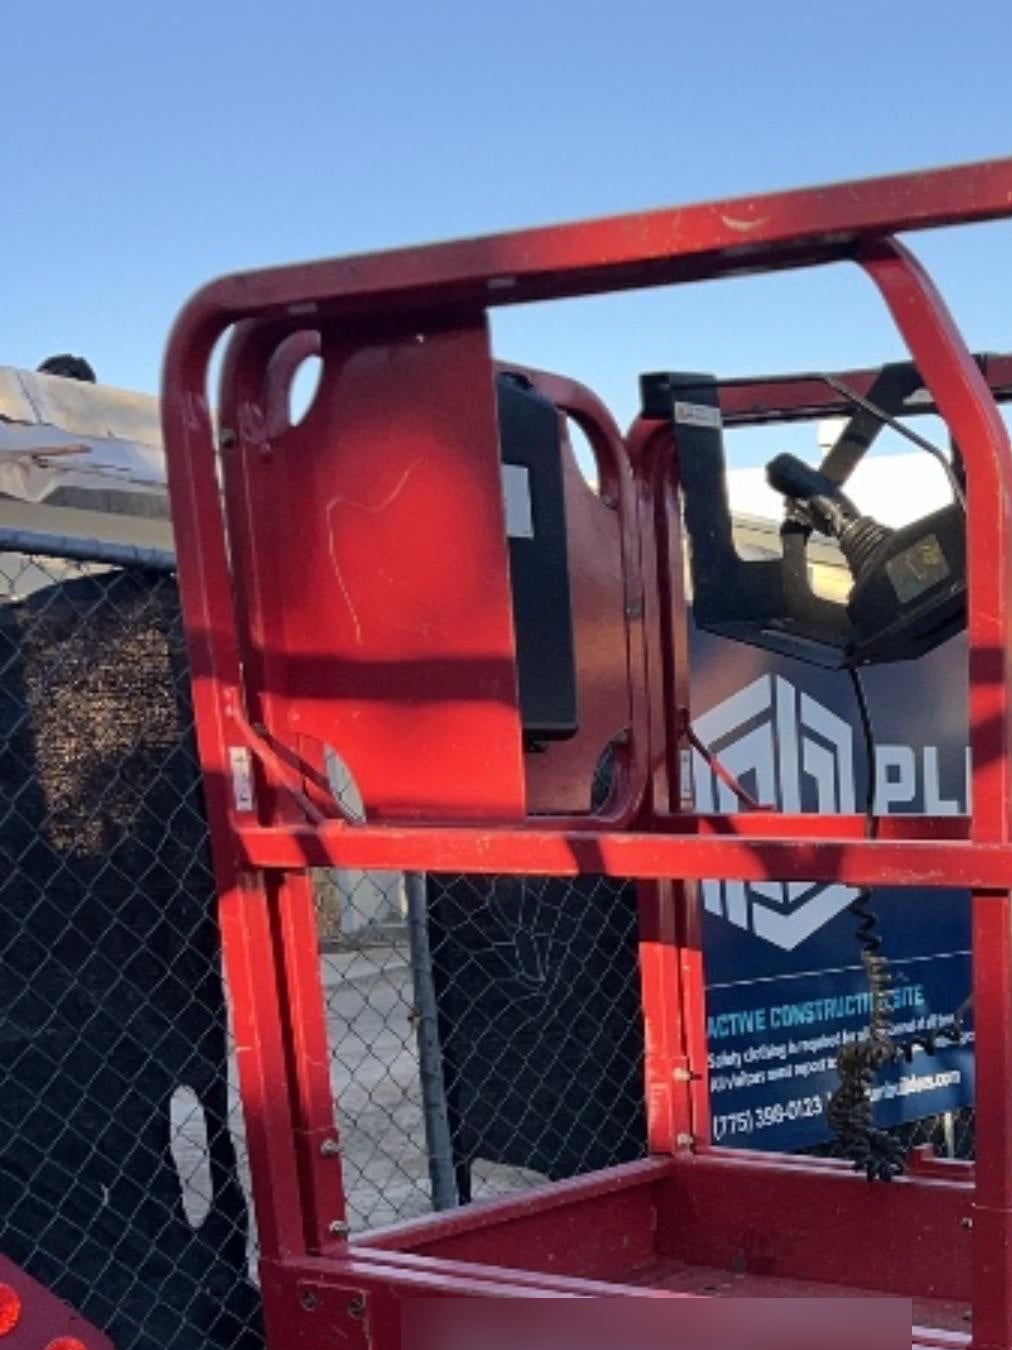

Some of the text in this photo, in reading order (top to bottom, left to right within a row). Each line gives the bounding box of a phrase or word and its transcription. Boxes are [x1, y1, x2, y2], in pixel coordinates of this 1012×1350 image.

[708, 985, 925, 1039] ACTIVE CONSTRUCTI SITE
[713, 1108, 754, 1141] (775)
